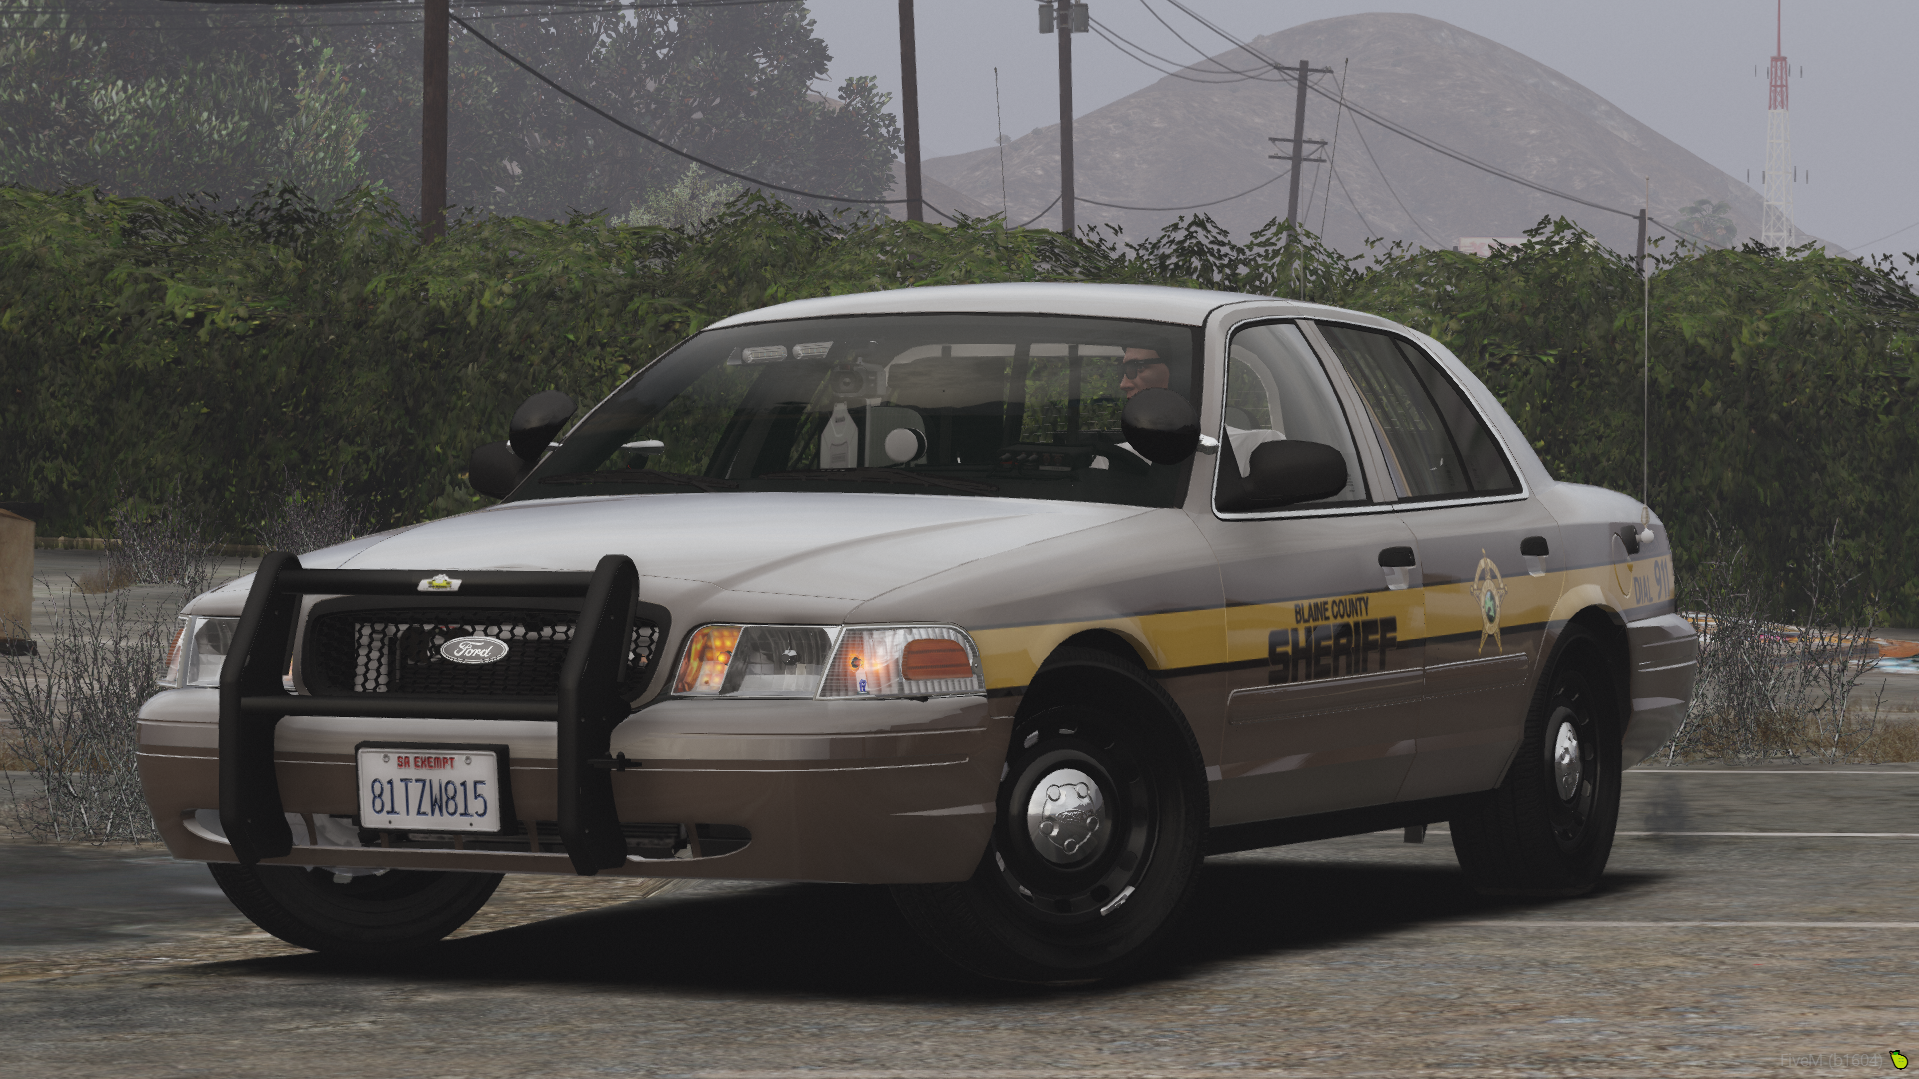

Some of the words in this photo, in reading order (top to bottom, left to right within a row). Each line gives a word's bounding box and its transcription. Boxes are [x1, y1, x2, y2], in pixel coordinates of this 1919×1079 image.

[1633, 574, 1653, 605] DIAL
[1654, 558, 1670, 600] 911
[1294, 601, 1330, 624] BLAINE
[1331, 596, 1369, 619] COUNTY
[453, 641, 494, 658] Ford
[1268, 616, 1397, 685] SHERIFF
[397, 755, 410, 768] SA
[414, 756, 455, 769] EXEMPT
[371, 778, 488, 818] 81TZW815
